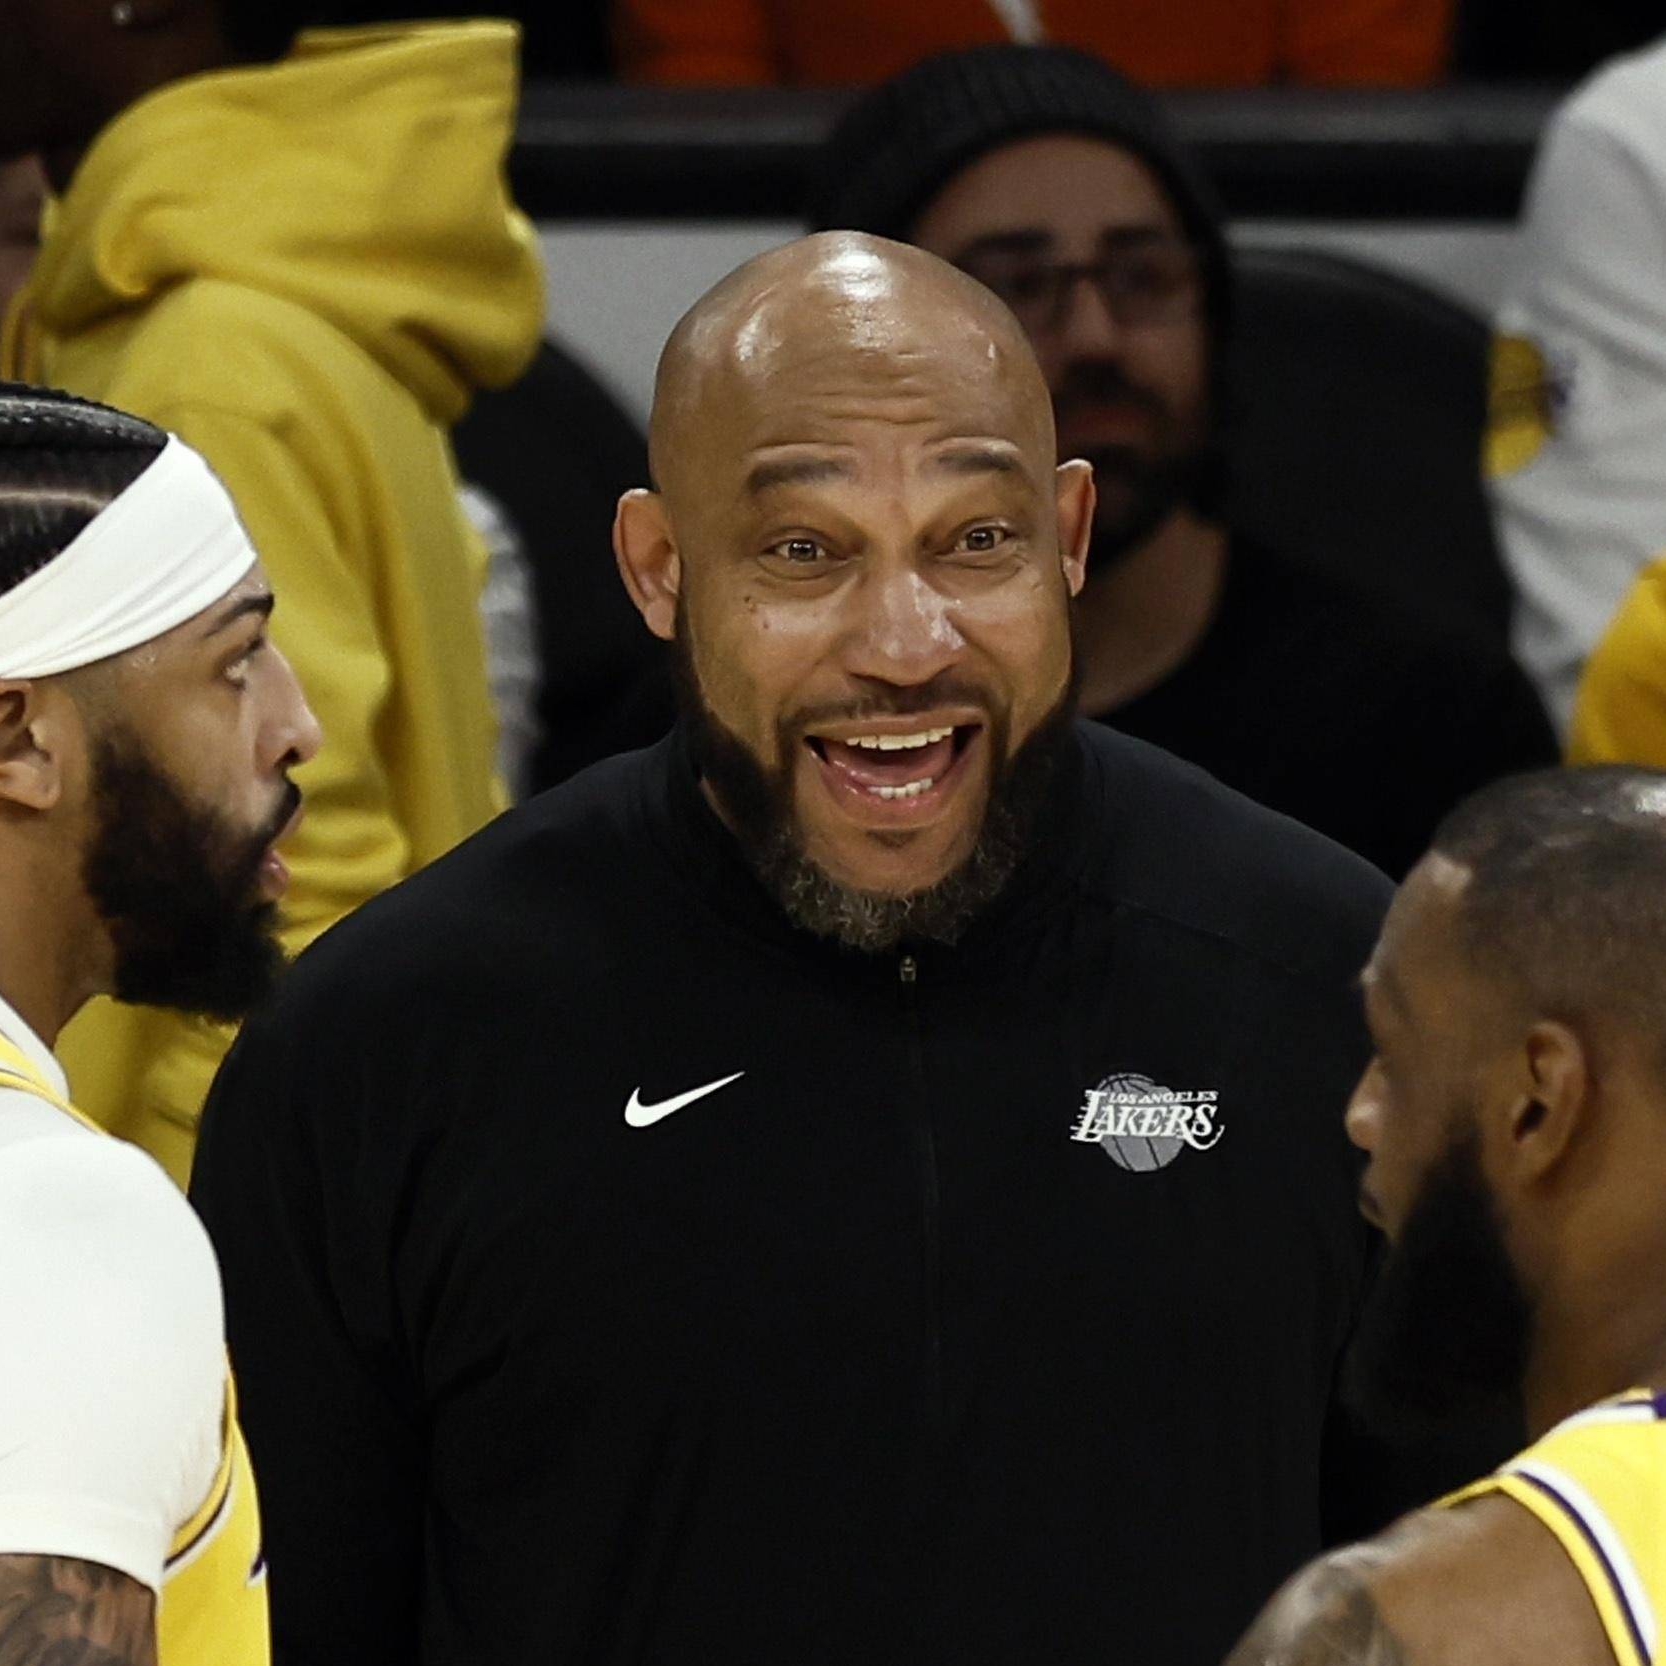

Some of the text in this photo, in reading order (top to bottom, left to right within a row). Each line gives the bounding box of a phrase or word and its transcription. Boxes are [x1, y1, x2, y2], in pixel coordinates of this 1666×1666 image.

[1109, 1090, 1219, 1104] LOS ANGELES
[1070, 1089, 1225, 1150] LAKERS
